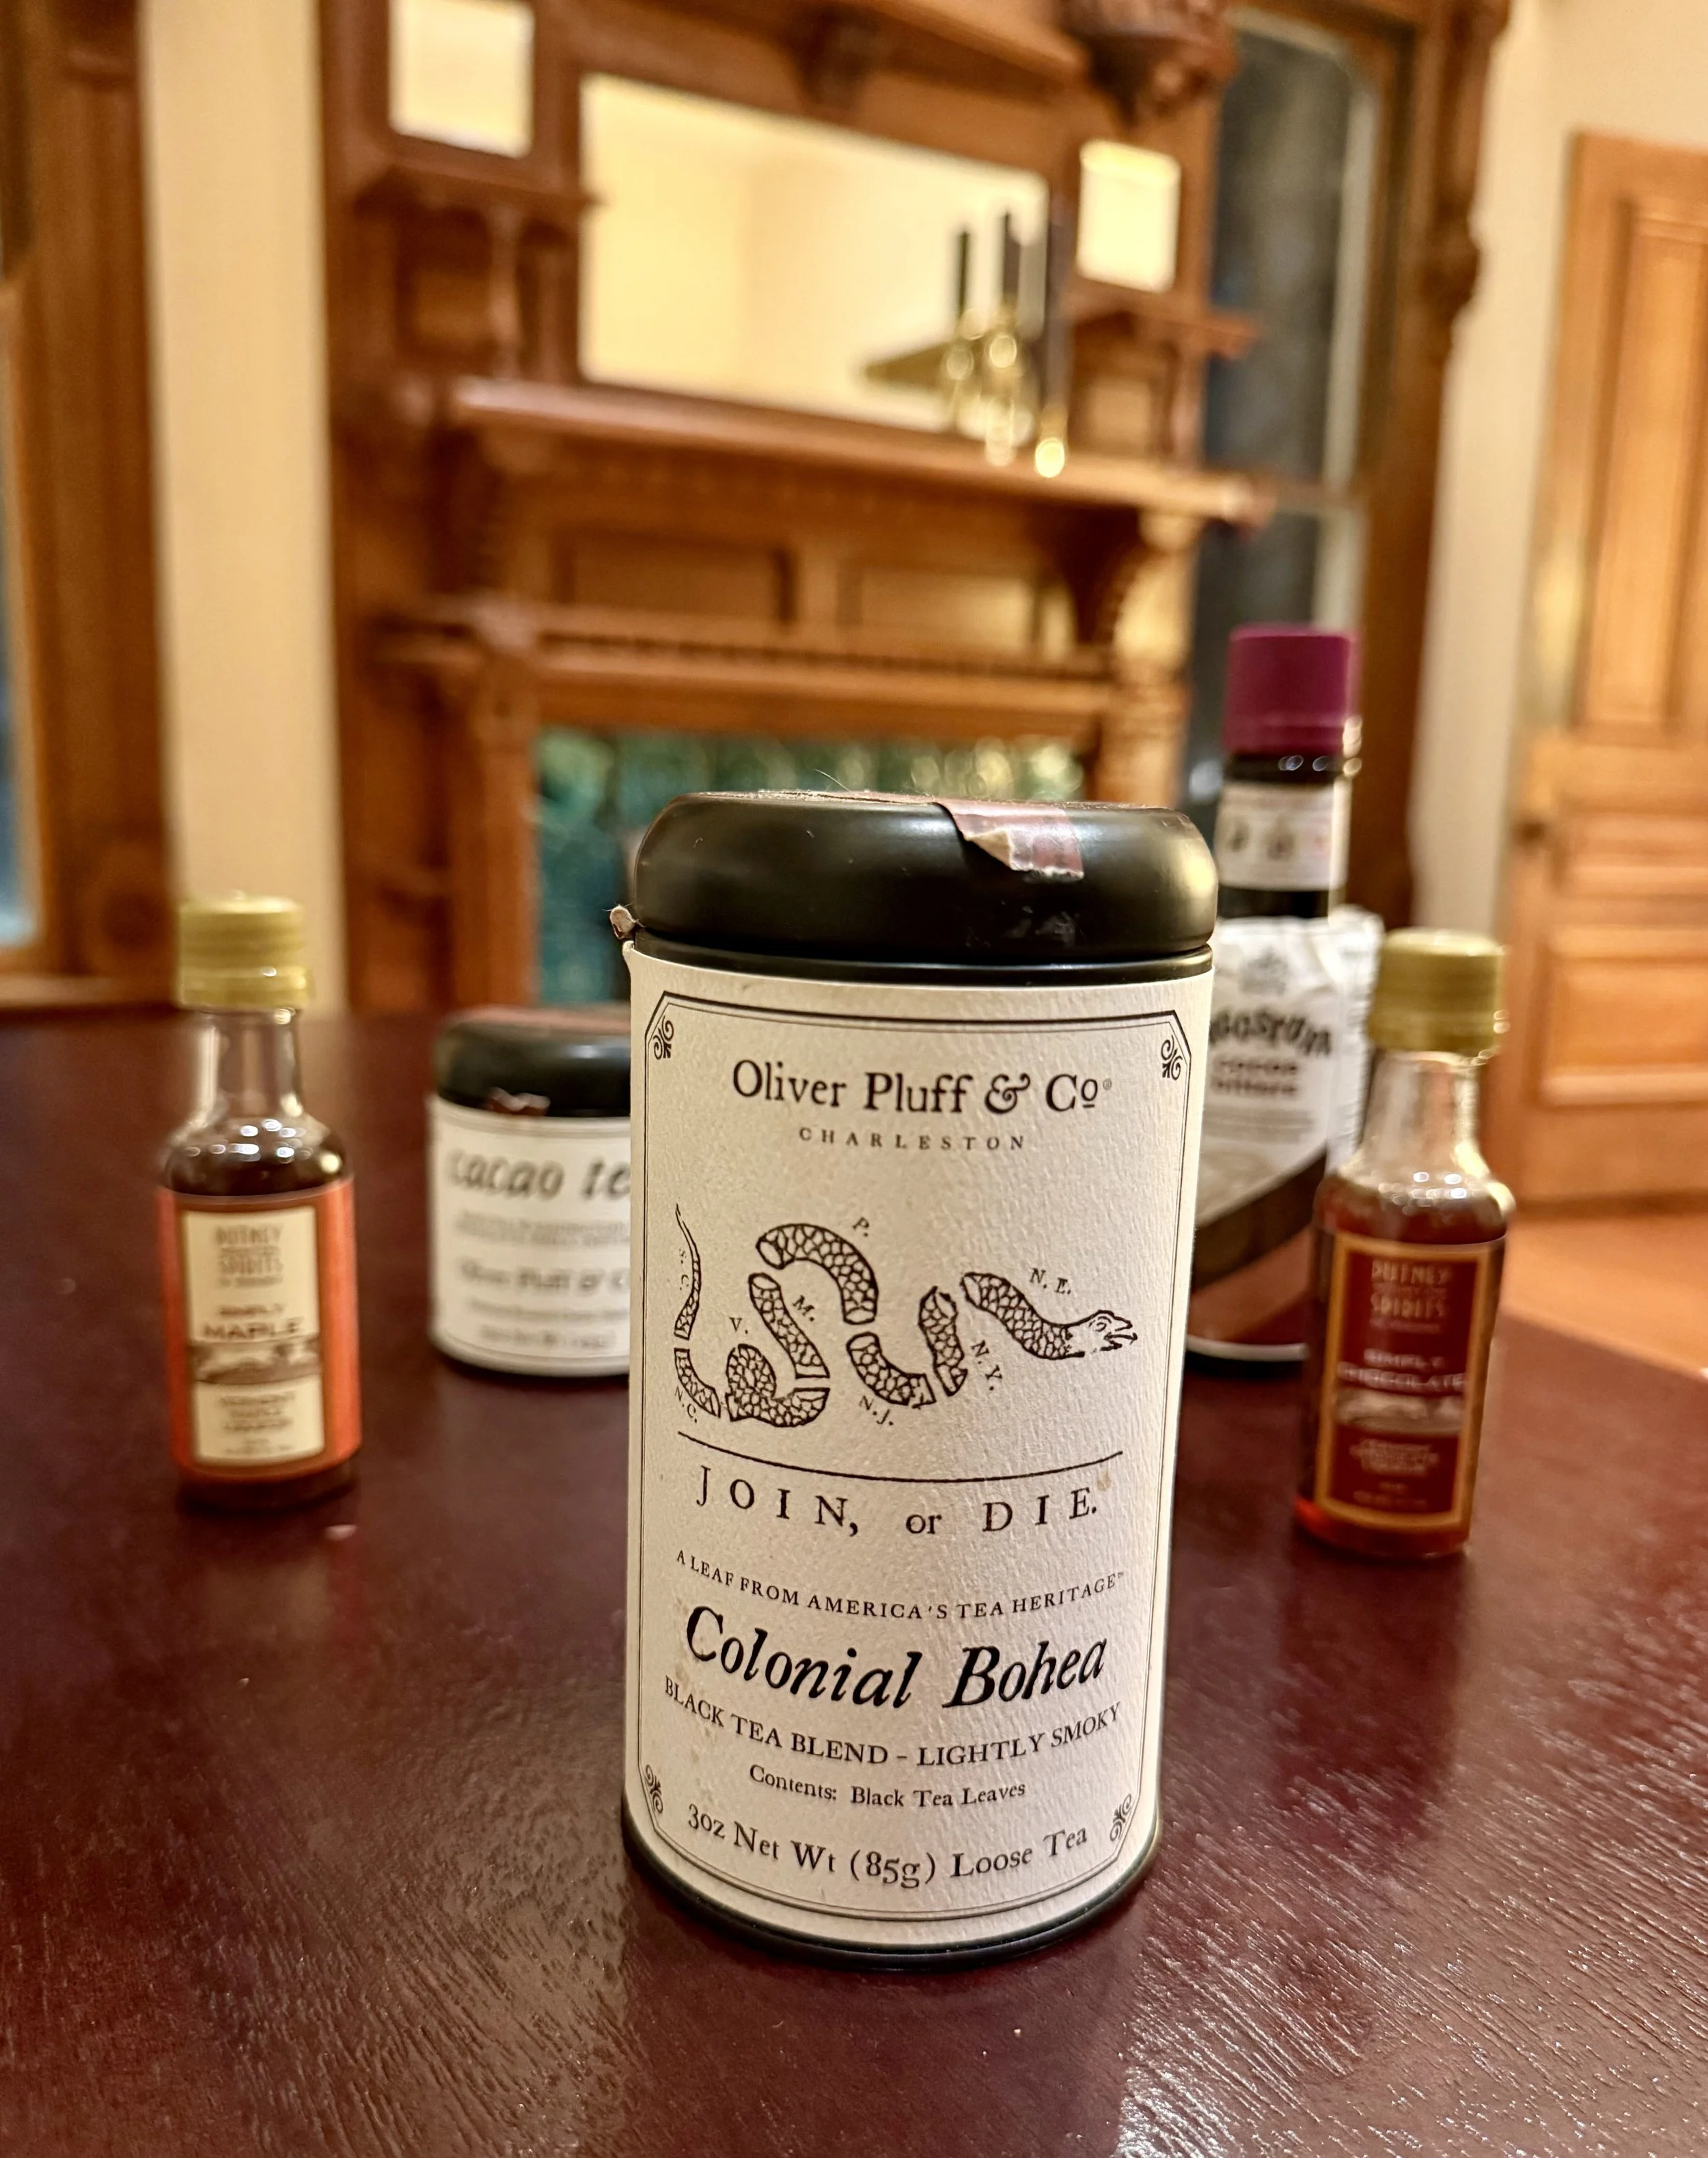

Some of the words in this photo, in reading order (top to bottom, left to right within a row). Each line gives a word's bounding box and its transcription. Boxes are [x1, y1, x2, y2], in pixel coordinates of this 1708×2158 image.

[733, 1060, 849, 1109] Oliver
[864, 1073, 975, 1115] Pluff
[984, 1073, 1032, 1116] &
[799, 1127, 1025, 1153] CHARLESTON
[729, 1316, 749, 1336] V.
[695, 1465, 859, 1537] JOIN,
[905, 1514, 943, 1536] or
[982, 1486, 1098, 1534] DIE.
[677, 1551, 687, 1566] A
[691, 1555, 735, 1588] LEAF
[741, 1577, 800, 1607] FROM
[807, 1595, 950, 1620] AMERICA'S
[956, 1602, 1005, 1622] TEA
[686, 1605, 923, 1709] Colonial
[942, 1637, 1108, 1709] Bohea
[665, 1676, 725, 1728] BLACK
[731, 1714, 784, 1749] TEA
[791, 1732, 890, 1766] BLEND
[917, 1732, 1047, 1768] LIGHTLY
[1051, 1702, 1121, 1749] SMOKY
[750, 1765, 838, 1803] Contents:
[851, 1786, 906, 1808] Black
[913, 1790, 954, 1810] Tea
[960, 1784, 1026, 1808] Leaves
[688, 1803, 726, 1841] 3oz
[734, 1821, 780, 1862] Net
[791, 1840, 836, 1874] Wt
[851, 1850, 937, 1892] (85g)
[950, 1849, 1034, 1880] Loose
[1043, 1828, 1088, 1861] Tea
